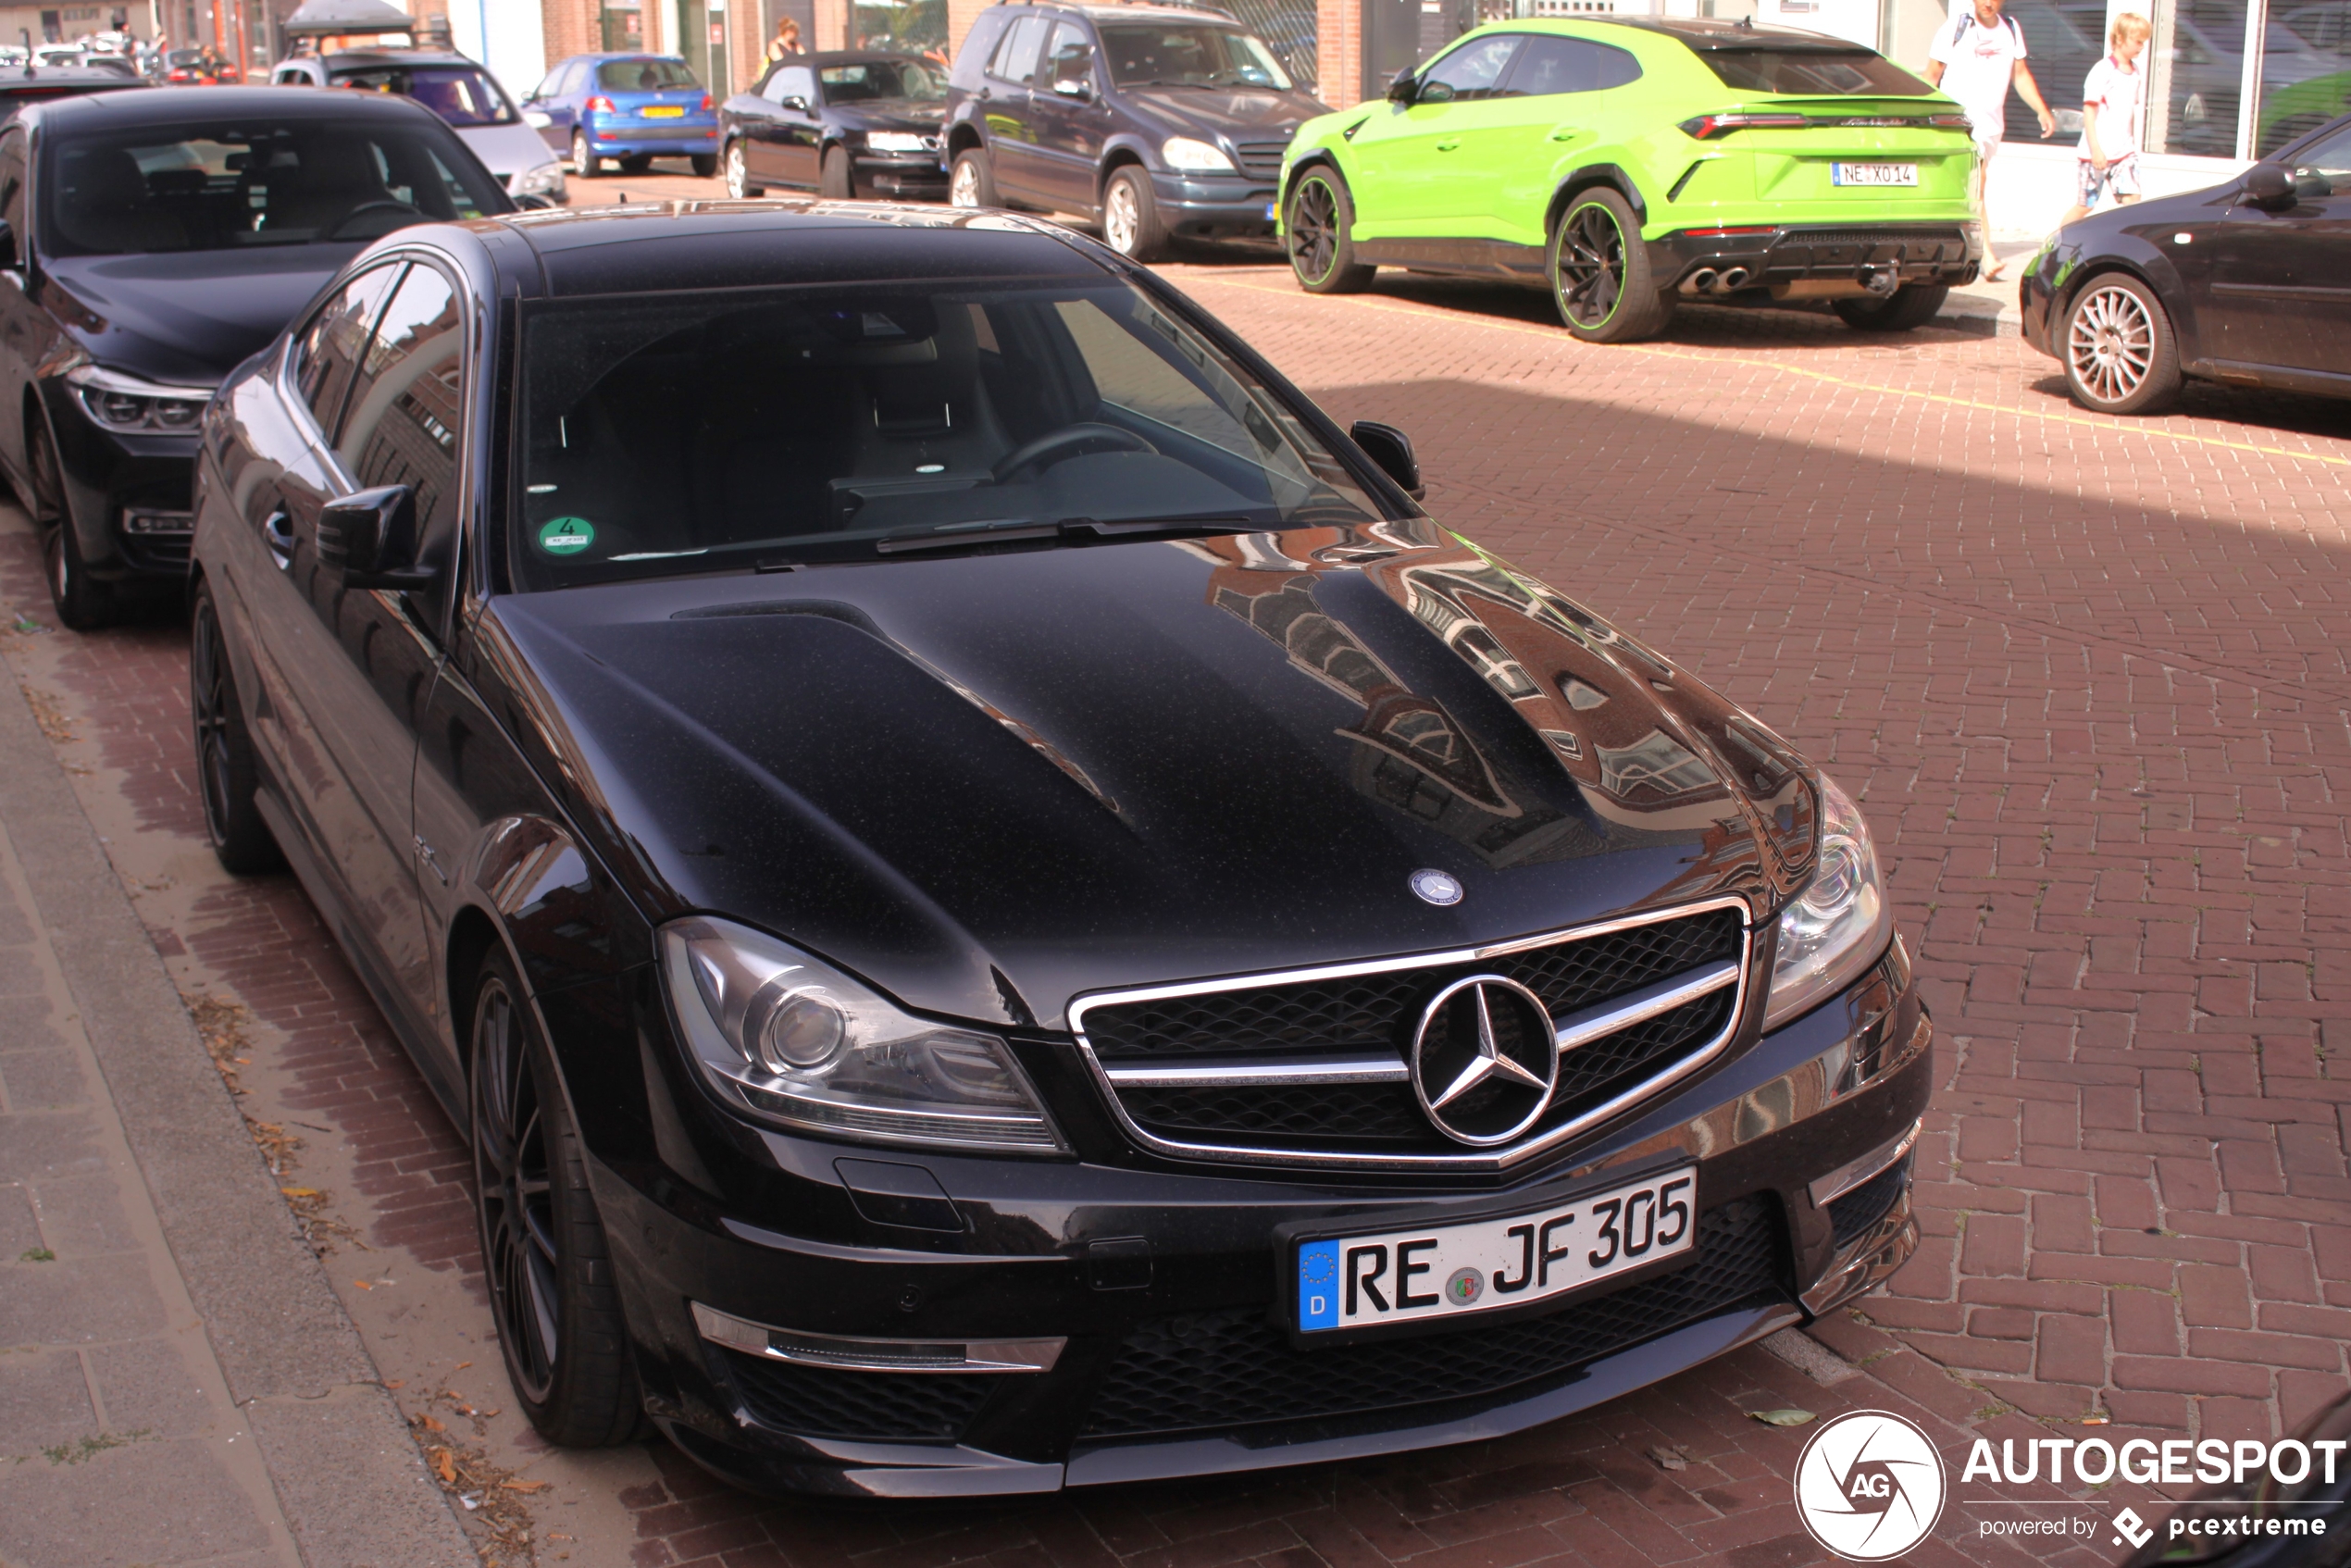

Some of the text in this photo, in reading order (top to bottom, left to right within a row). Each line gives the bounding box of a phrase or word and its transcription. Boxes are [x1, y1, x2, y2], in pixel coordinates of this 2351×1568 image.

[1845, 166, 1863, 182] NE
[1894, 166, 1910, 182] 14
[559, 518, 575, 535] 4
[1345, 1237, 1440, 1315] RE
[1492, 1212, 1575, 1294] JF
[1587, 1176, 1691, 1269] 305
[1310, 1295, 1325, 1315] D
